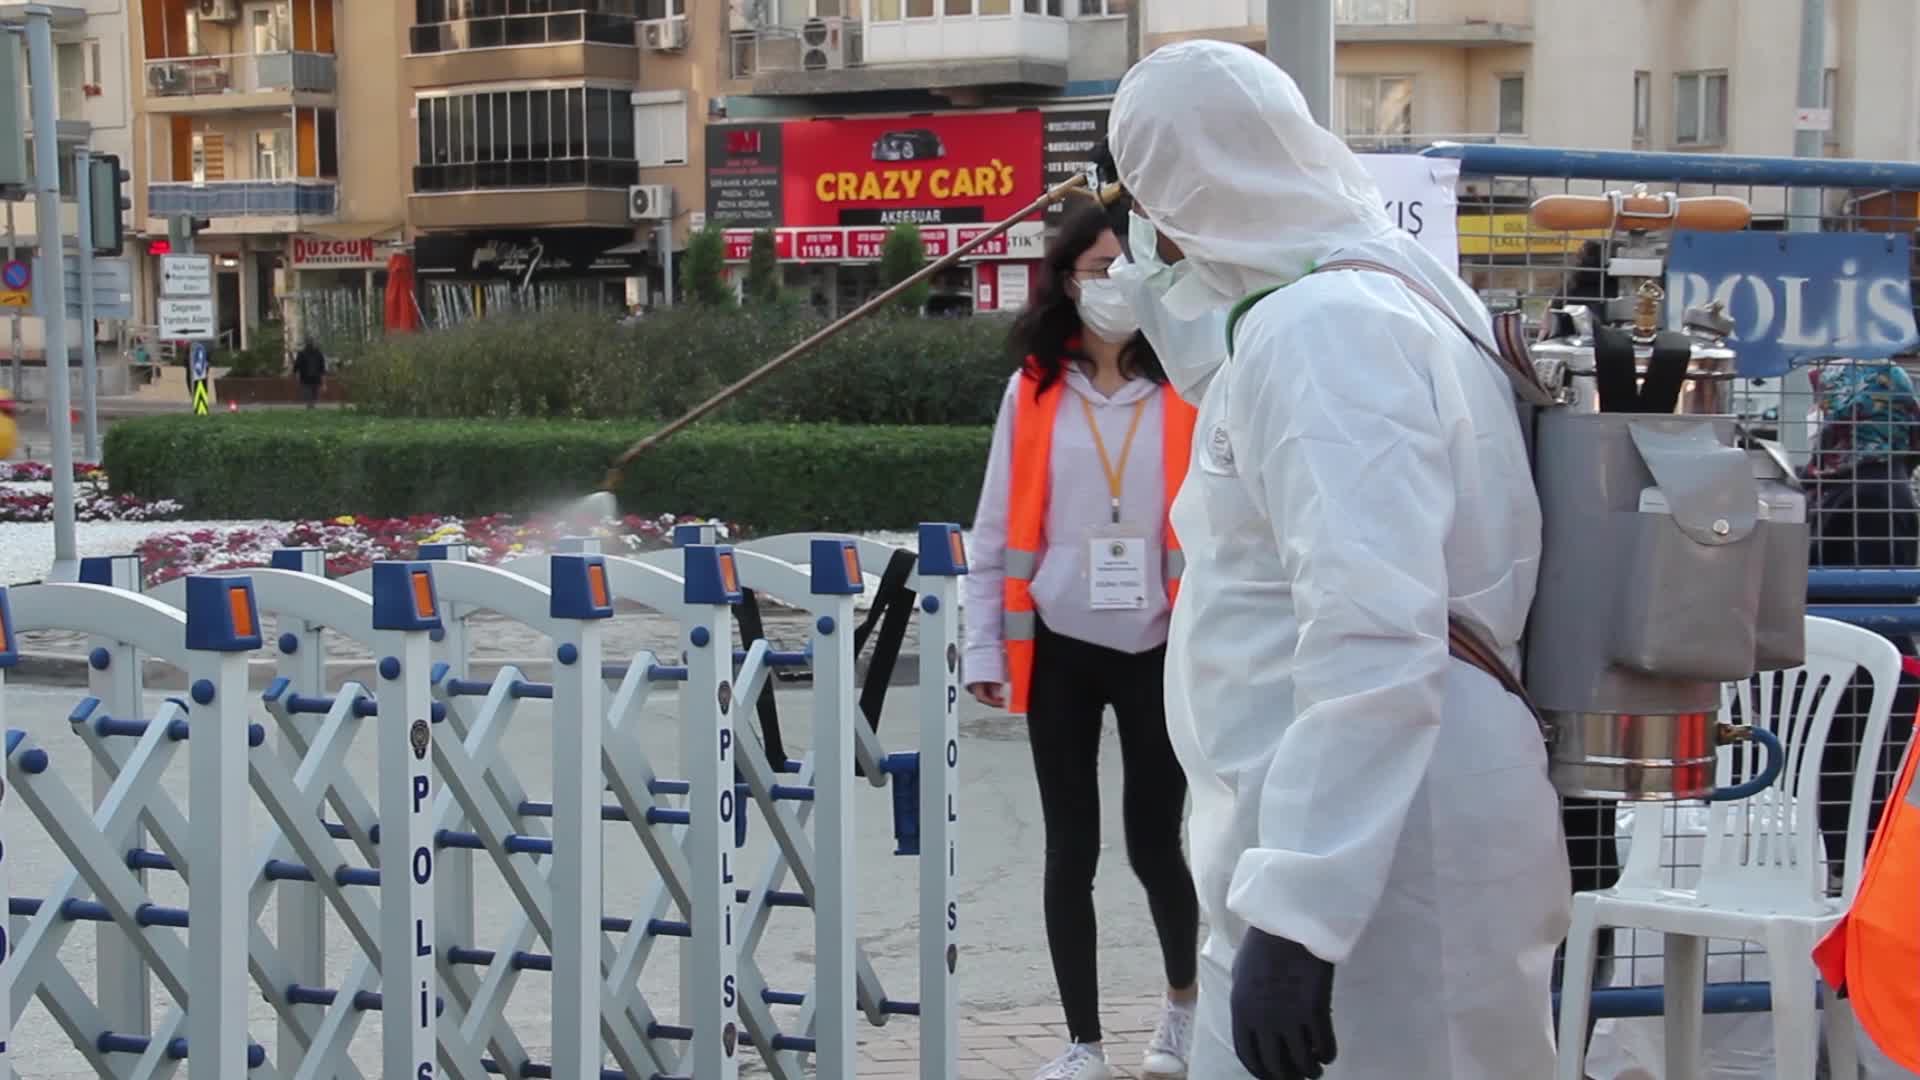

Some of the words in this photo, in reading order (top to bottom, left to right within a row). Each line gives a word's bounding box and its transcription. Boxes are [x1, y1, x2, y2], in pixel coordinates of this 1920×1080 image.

[816, 168, 923, 203] CRAZY
[929, 158, 1014, 199] CAR'S
[880, 209, 942, 224] AKSESUAR
[1384, 200, 1424, 240] IŞ
[1669, 259, 1918, 349] POLİS
[946, 685, 957, 931] POLİS
[719, 728, 735, 1008] POLİS
